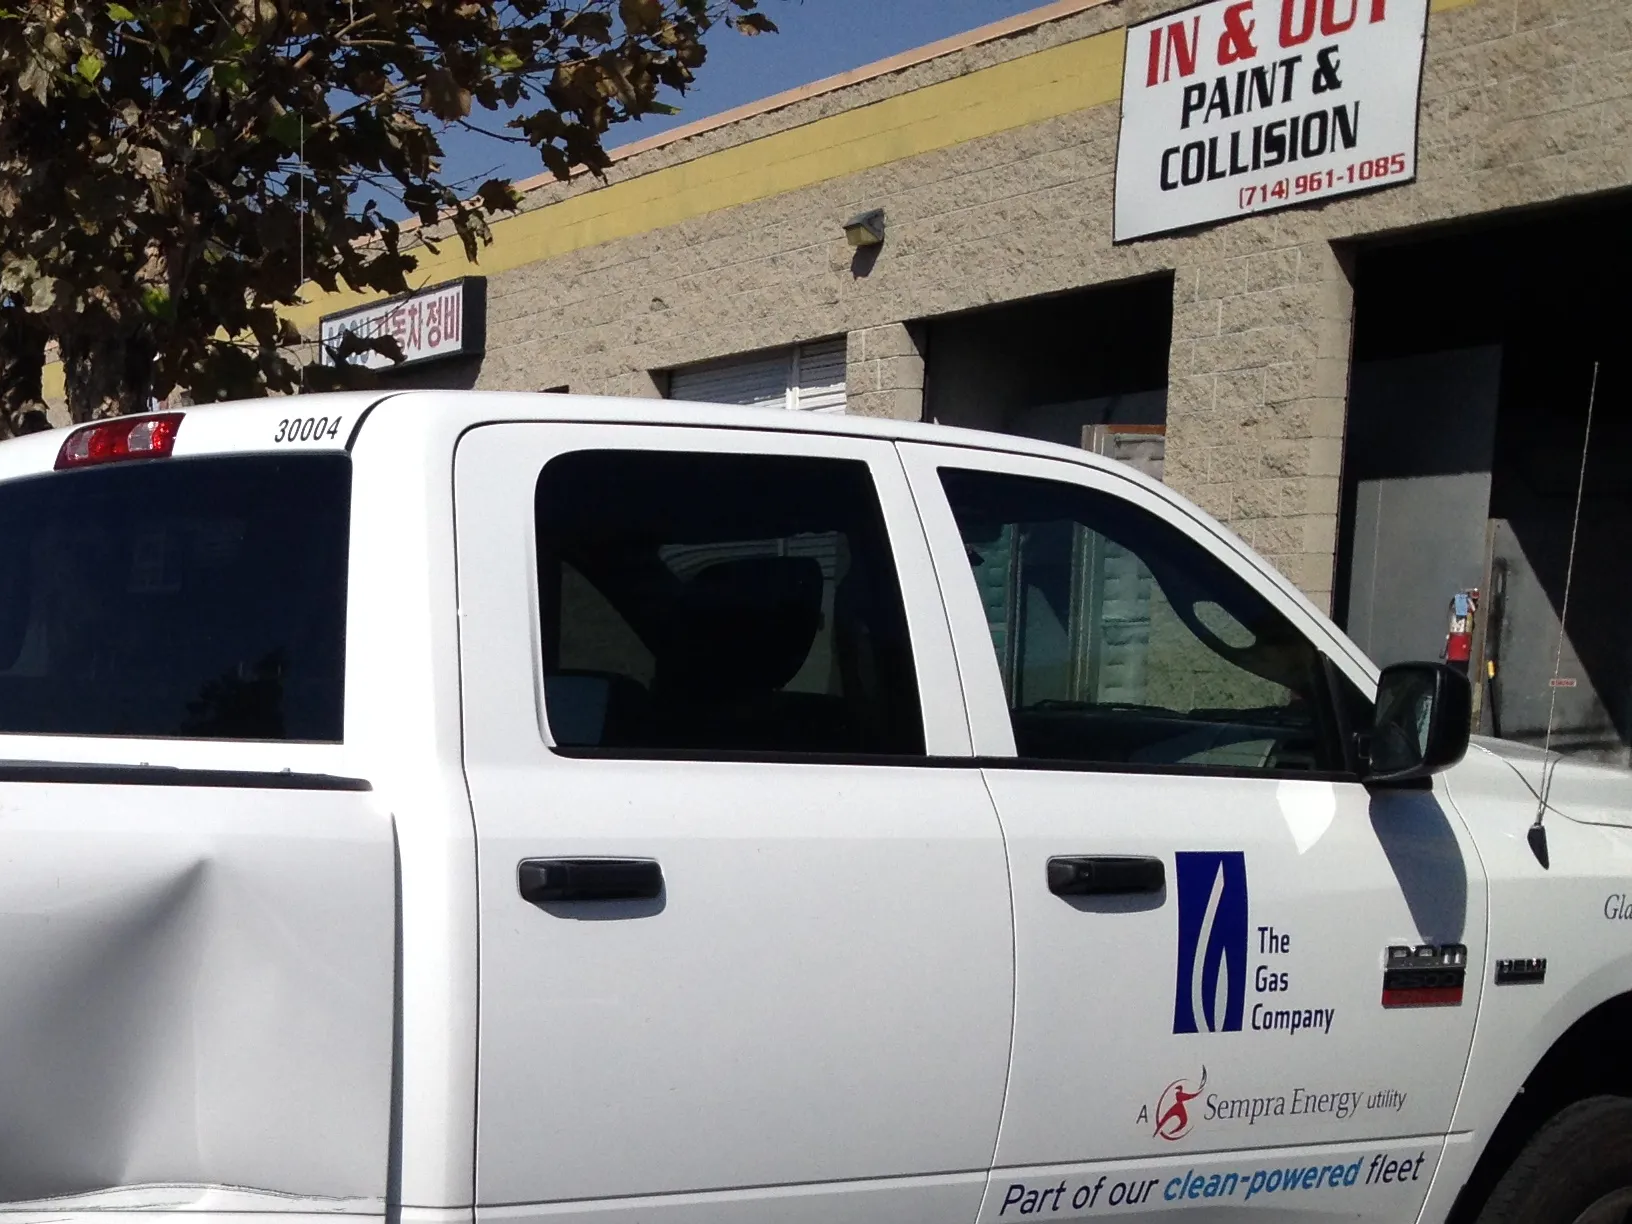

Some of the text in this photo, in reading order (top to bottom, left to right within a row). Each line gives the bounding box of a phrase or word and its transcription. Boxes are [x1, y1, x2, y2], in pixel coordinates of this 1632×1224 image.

[1146, 16, 1200, 87] IN
[1218, 1, 1258, 65] &
[1180, 45, 1342, 129] PAINT &
[1160, 101, 1360, 191] COLLISION
[1239, 153, 1405, 209] (714) 961-1085
[274, 416, 342, 443] 30004
[1258, 926, 1290, 953] The
[1255, 965, 1289, 992] Gas
[1252, 1003, 1335, 1035] Company
[1136, 1088, 1407, 1124] A Sempra Energy utility
[999, 1151, 1425, 1216] Part of our clean-powered fleet
